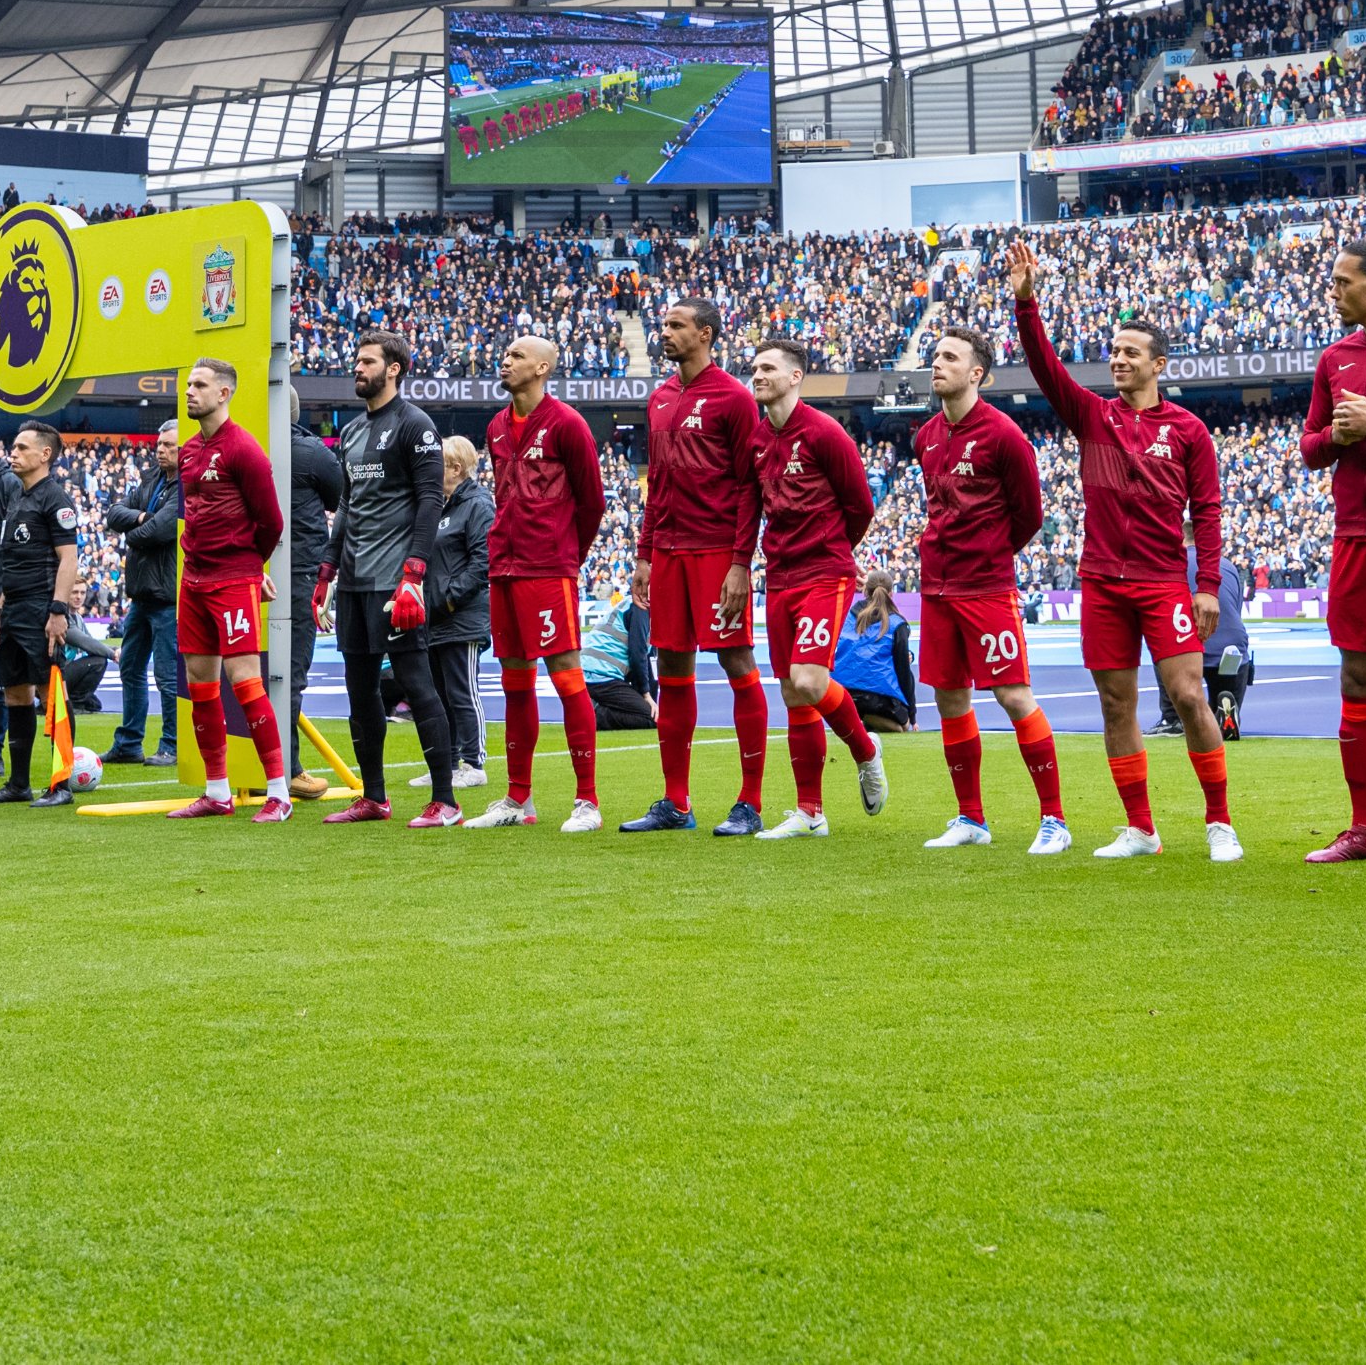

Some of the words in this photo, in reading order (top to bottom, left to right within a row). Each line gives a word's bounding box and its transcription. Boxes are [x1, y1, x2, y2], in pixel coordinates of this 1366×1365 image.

[1170, 54, 1187, 65] 301
[1118, 146, 1153, 162] MADE
[1157, 144, 1169, 158] IN
[1173, 138, 1250, 158] MANCHESTER
[150, 278, 167, 294] EA
[207, 272, 231, 284] LIVERPOOL
[103, 285, 120, 301] EA
[148, 293, 167, 303] SPORTS
[102, 300, 120, 309] SPORTS
[1235, 354, 1266, 376] TO
[1275, 351, 1315, 374] THE
[400, 380, 473, 401] LCOME
[478, 381, 509, 401] TO
[566, 377, 648, 400] ETIHAD
[680, 415, 703, 430] AXA
[523, 447, 543, 459] AXA
[1145, 442, 1172, 459] AXA
[353, 462, 383, 471] standard
[353, 469, 385, 479] chartered
[783, 461, 804, 475] AXA
[951, 461, 975, 476] AXA
[200, 469, 219, 481] AXA
[223, 608, 250, 637] 14
[539, 610, 556, 638] 3
[1172, 603, 1192, 633] 6
[796, 617, 831, 647] 26
[980, 630, 1019, 663] 20
